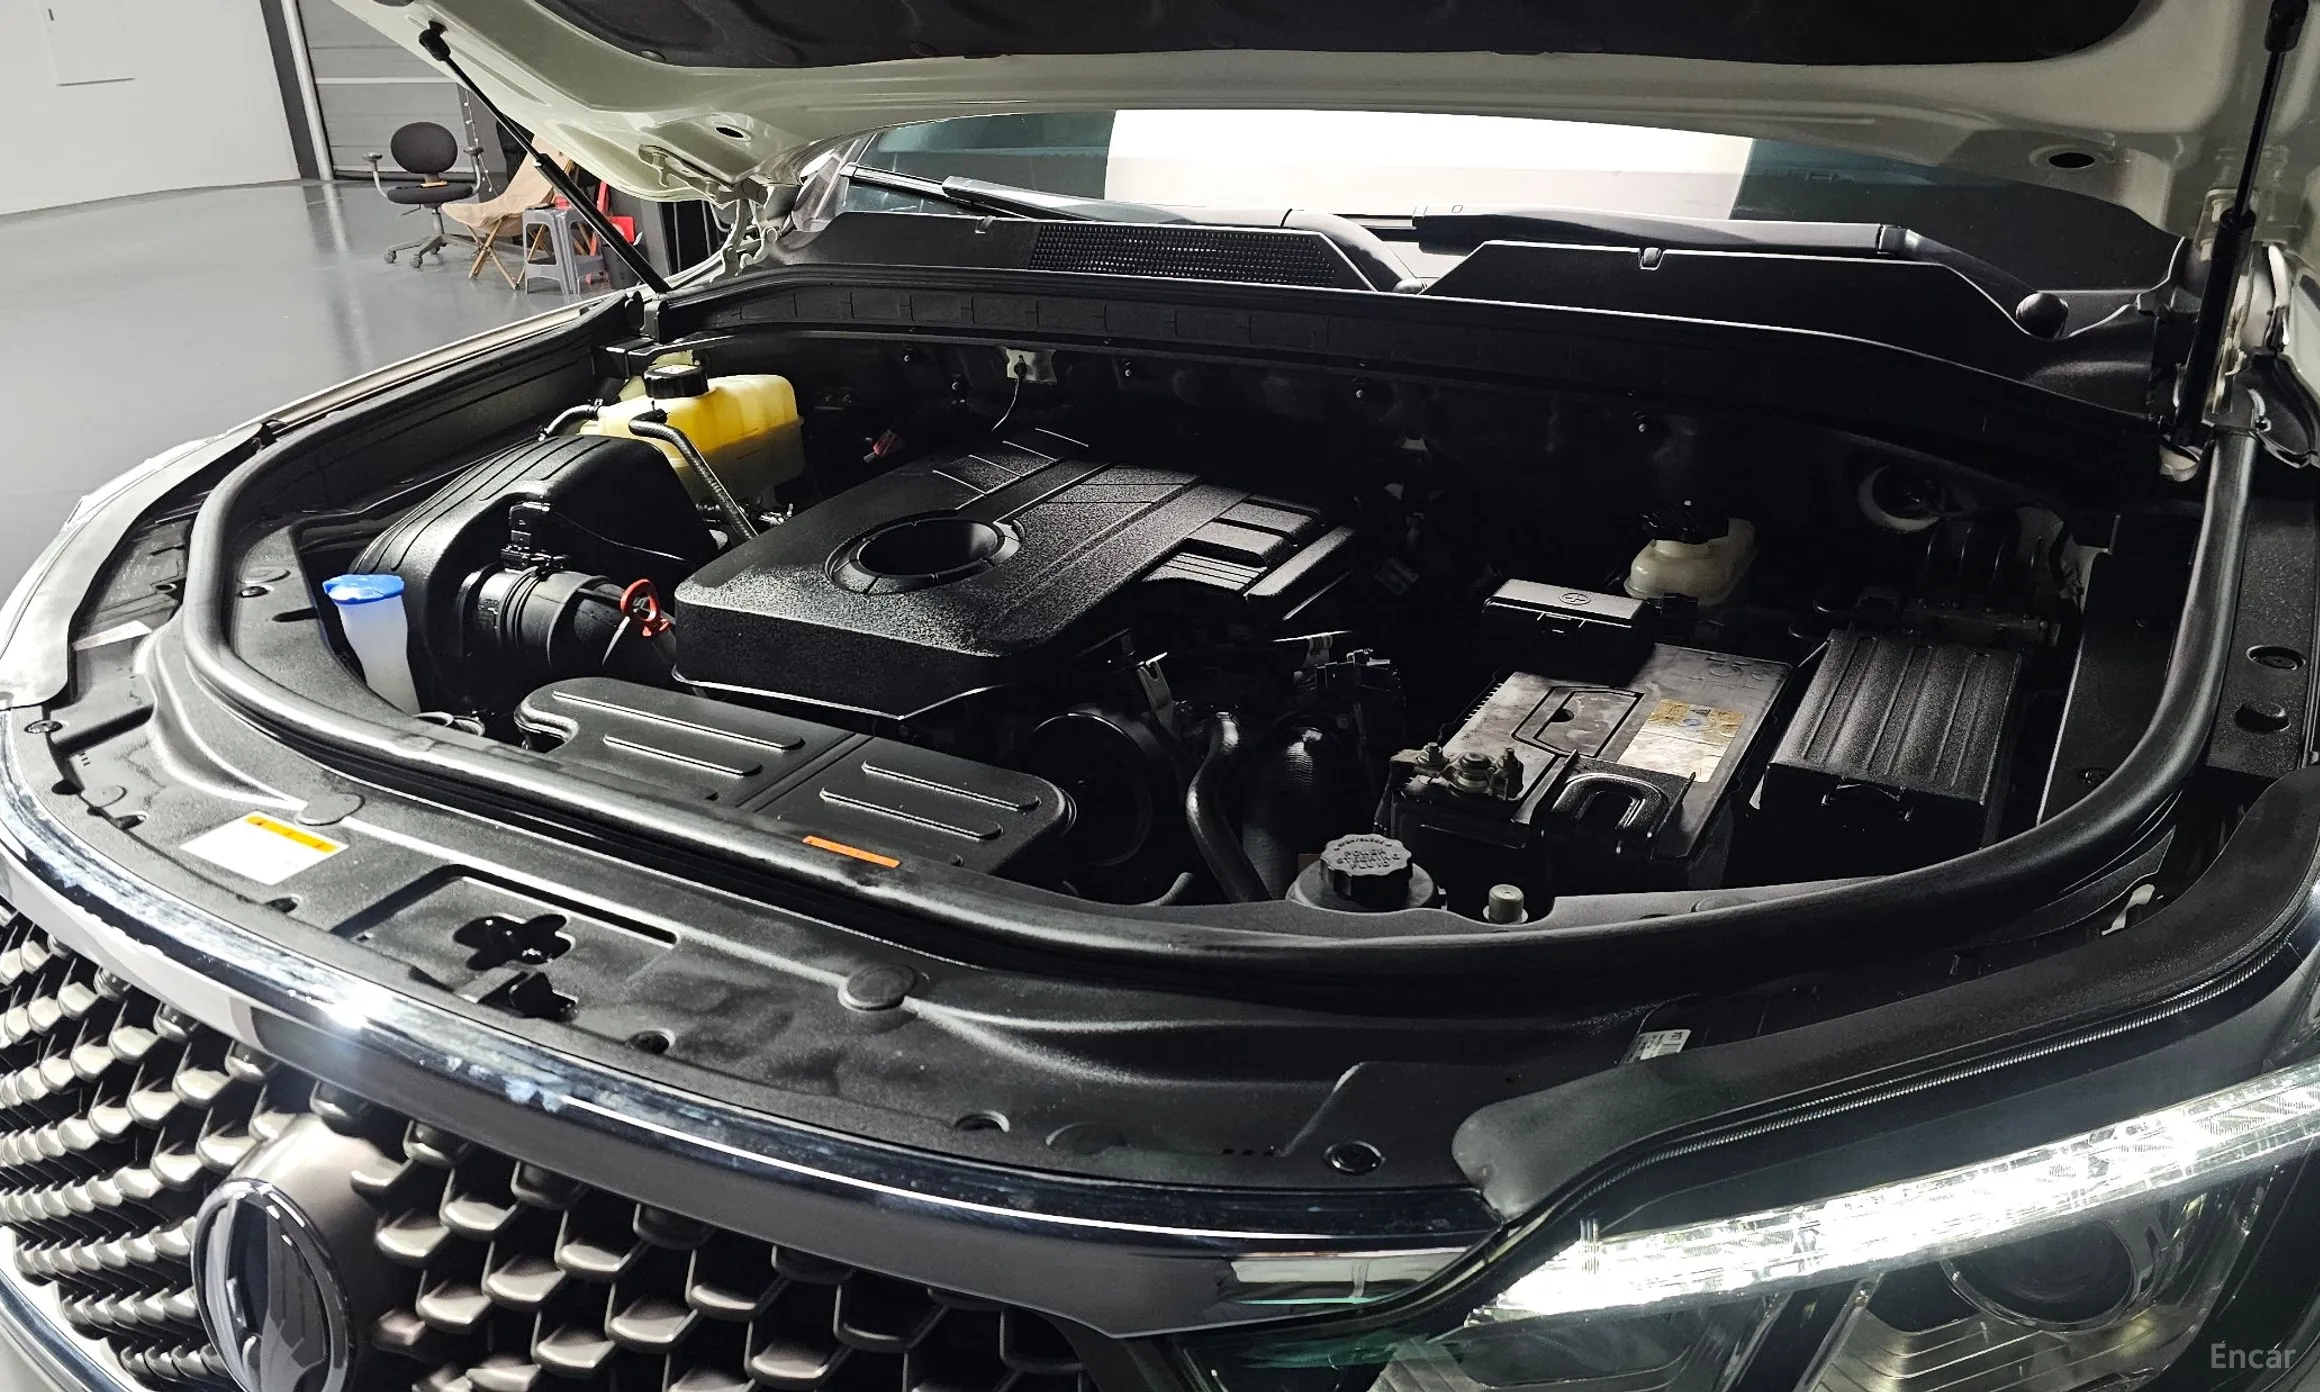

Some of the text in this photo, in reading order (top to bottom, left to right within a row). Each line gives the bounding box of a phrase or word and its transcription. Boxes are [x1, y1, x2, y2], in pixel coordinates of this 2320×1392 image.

[1343, 848, 1386, 858] POWER
[1336, 853, 1400, 864] STEERING
[1350, 860, 1390, 870] FLUID
